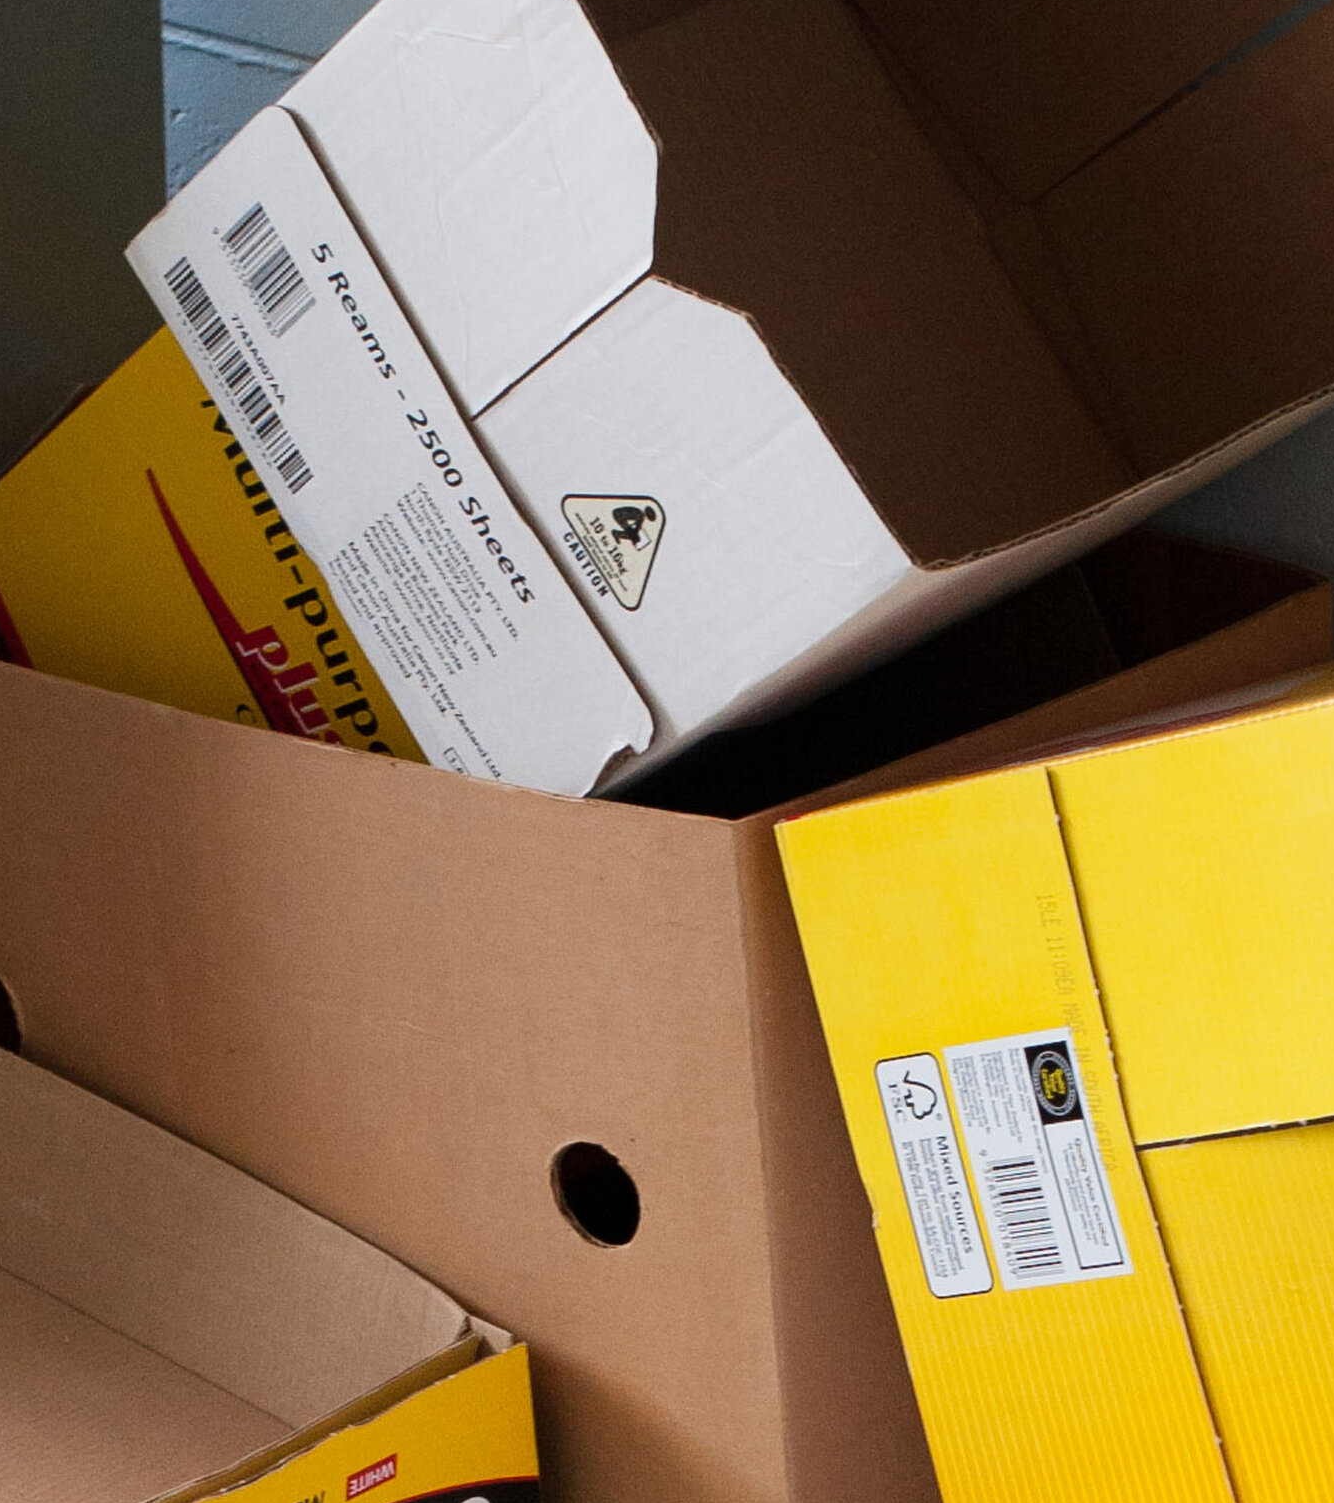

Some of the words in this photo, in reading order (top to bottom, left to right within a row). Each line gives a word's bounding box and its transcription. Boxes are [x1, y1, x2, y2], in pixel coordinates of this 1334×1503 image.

[312, 244, 333, 263] 5
[328, 272, 394, 378] Reams
[407, 410, 462, 487] 2500
[460, 497, 533, 602] Sheets
[564, 532, 608, 596] CAUTION
[937, 1136, 958, 1185] Mixed
[951, 1191, 972, 1253] Sources
[349, 1459, 395, 1498] WHITE
